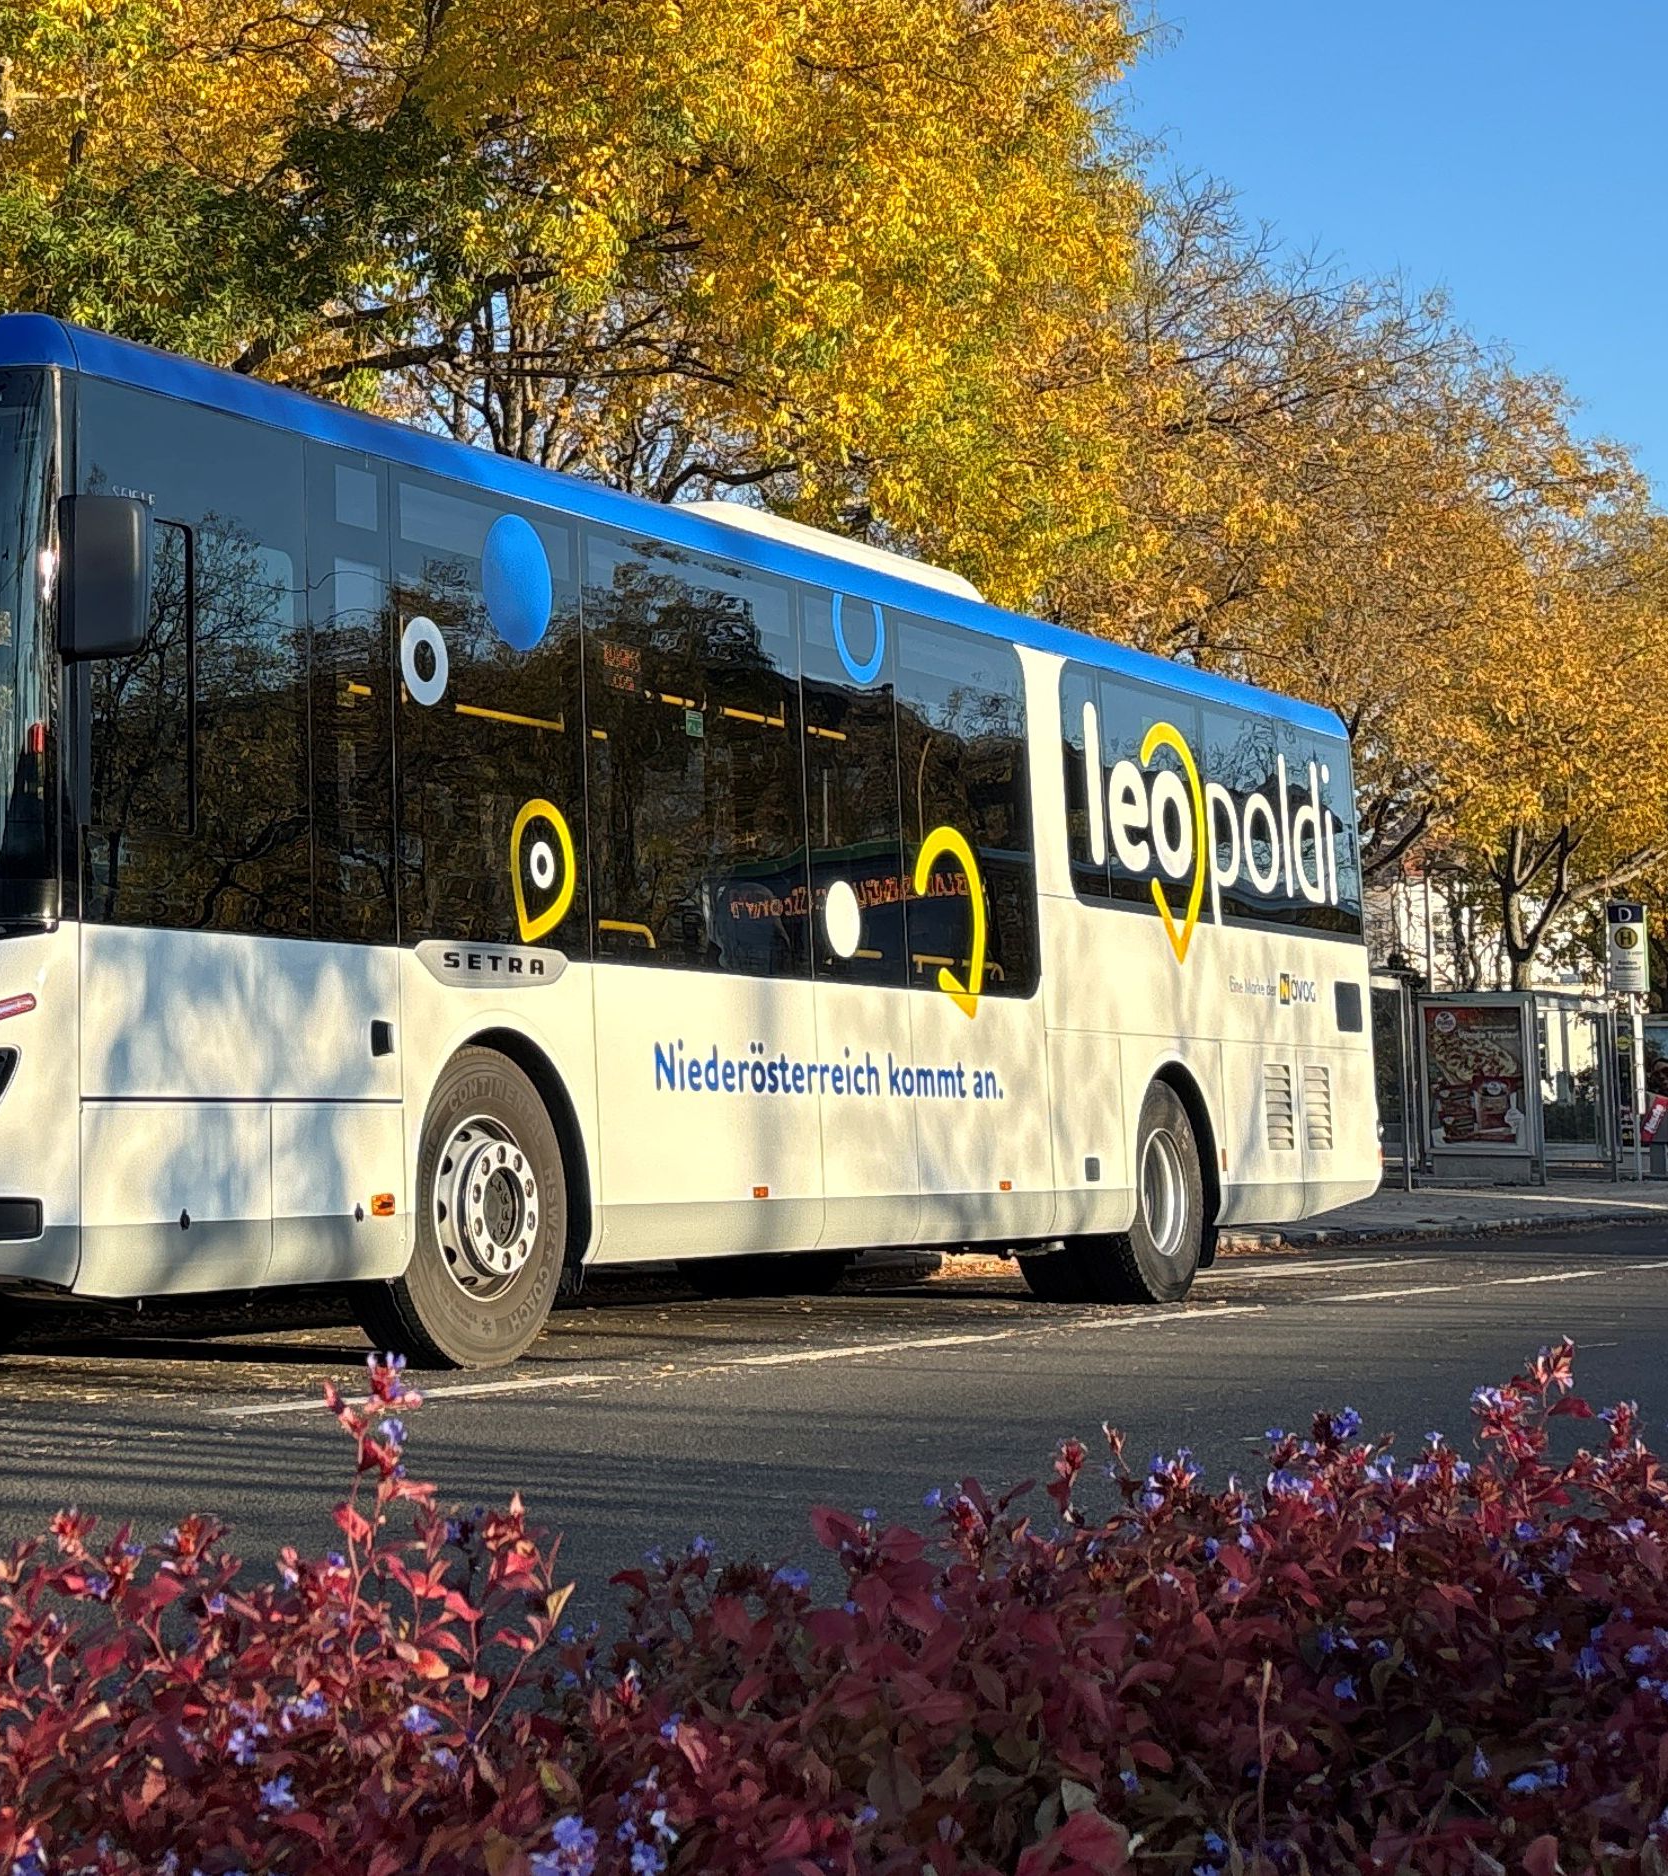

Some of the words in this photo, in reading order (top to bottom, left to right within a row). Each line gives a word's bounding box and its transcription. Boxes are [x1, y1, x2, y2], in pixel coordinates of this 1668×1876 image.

[1083, 701, 1337, 926] leopoldi
[1618, 906, 1632, 922] D
[1620, 931, 1632, 946] H
[443, 951, 545, 976] SETRA
[654, 1038, 881, 1096] Niederösterreich
[888, 1052, 967, 1099] kommt
[973, 1070, 1004, 1100] an.
[508, 1265, 552, 1333] COACH
